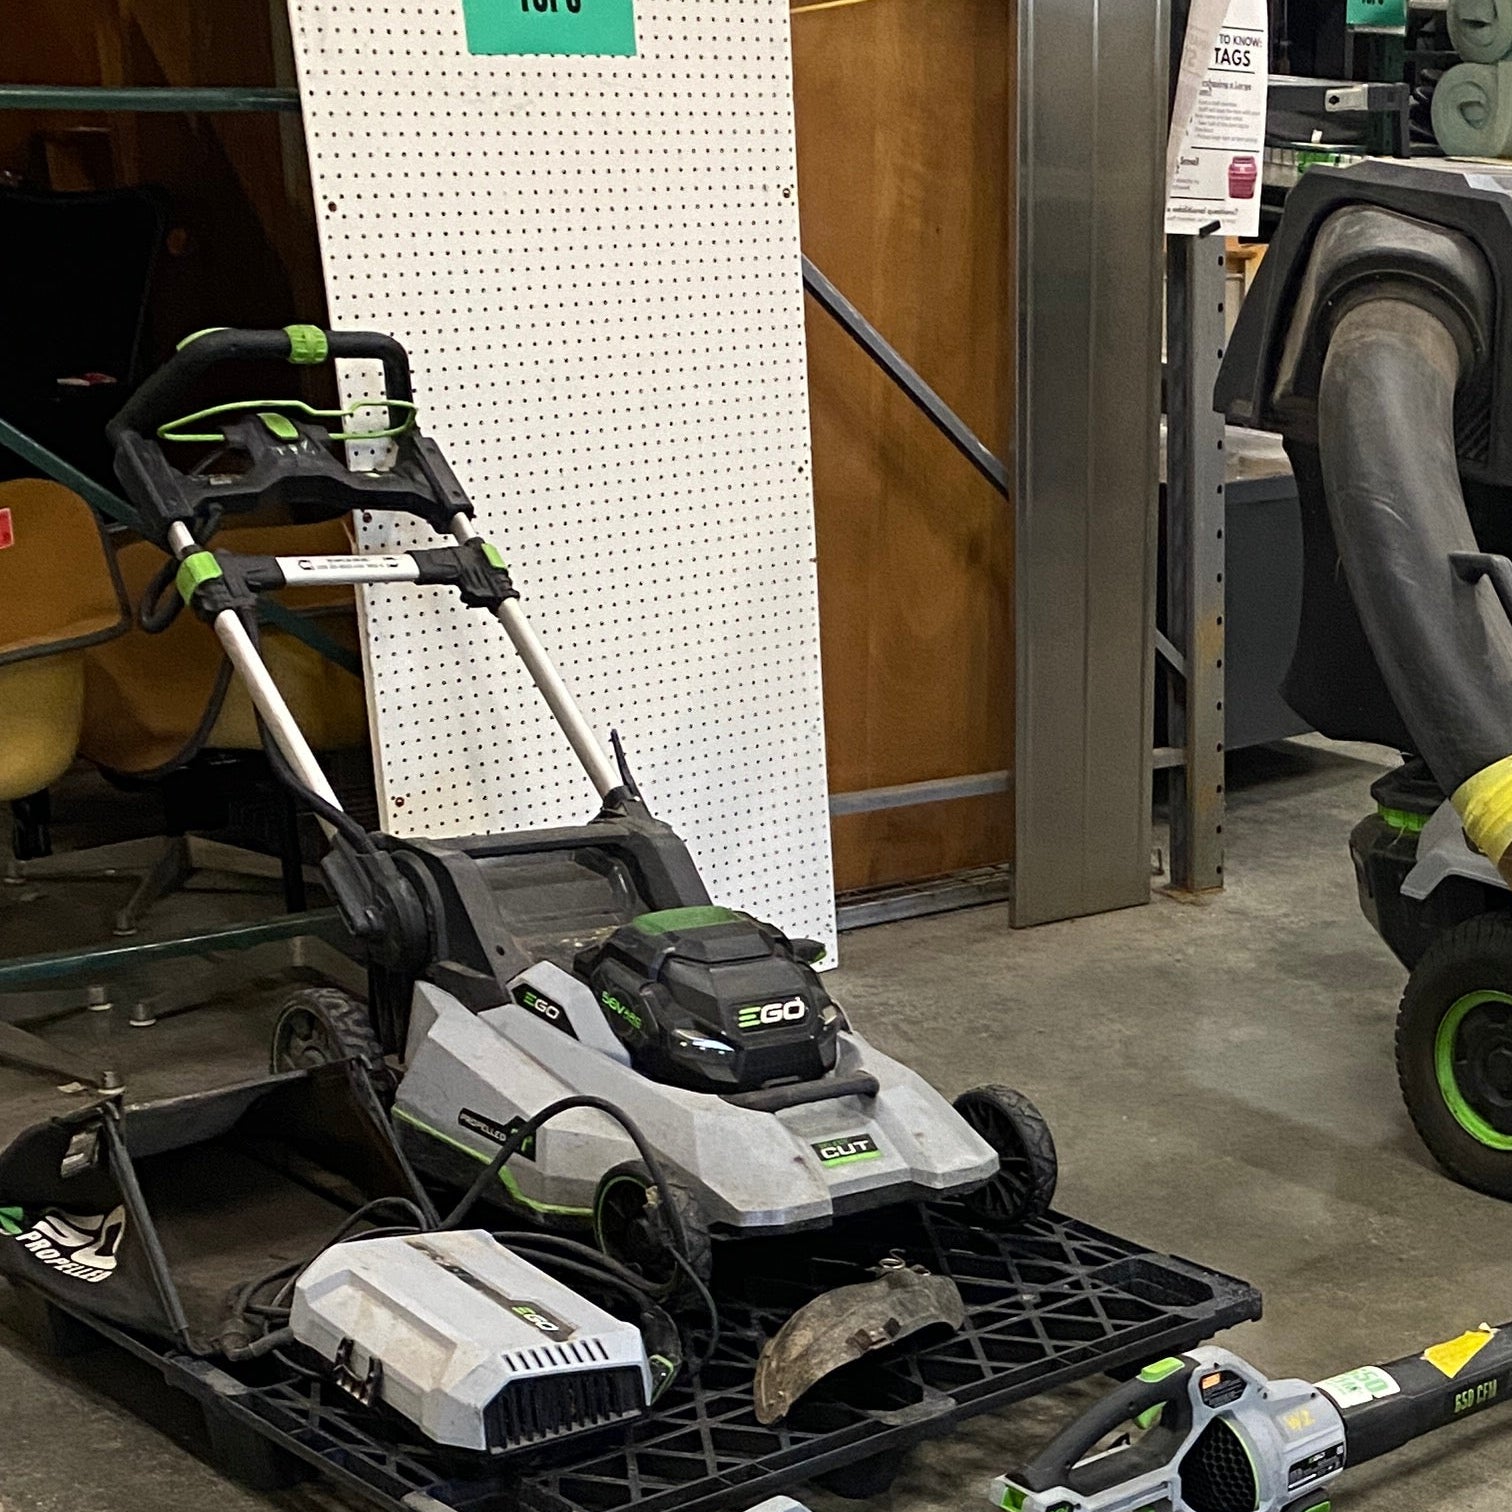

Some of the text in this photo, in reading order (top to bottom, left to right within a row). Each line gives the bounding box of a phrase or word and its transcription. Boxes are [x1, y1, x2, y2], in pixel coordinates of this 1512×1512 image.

[1218, 33, 1263, 48] TO KNOW:
[1214, 47, 1252, 67] TAGS
[523, 991, 561, 1020] EGO
[737, 1000, 805, 1029] EGO
[820, 1139, 870, 1160] CUT
[15, 1230, 113, 1283] PROPELLED
[511, 1305, 560, 1332] EGO
[1454, 1388, 1475, 1413] 650
